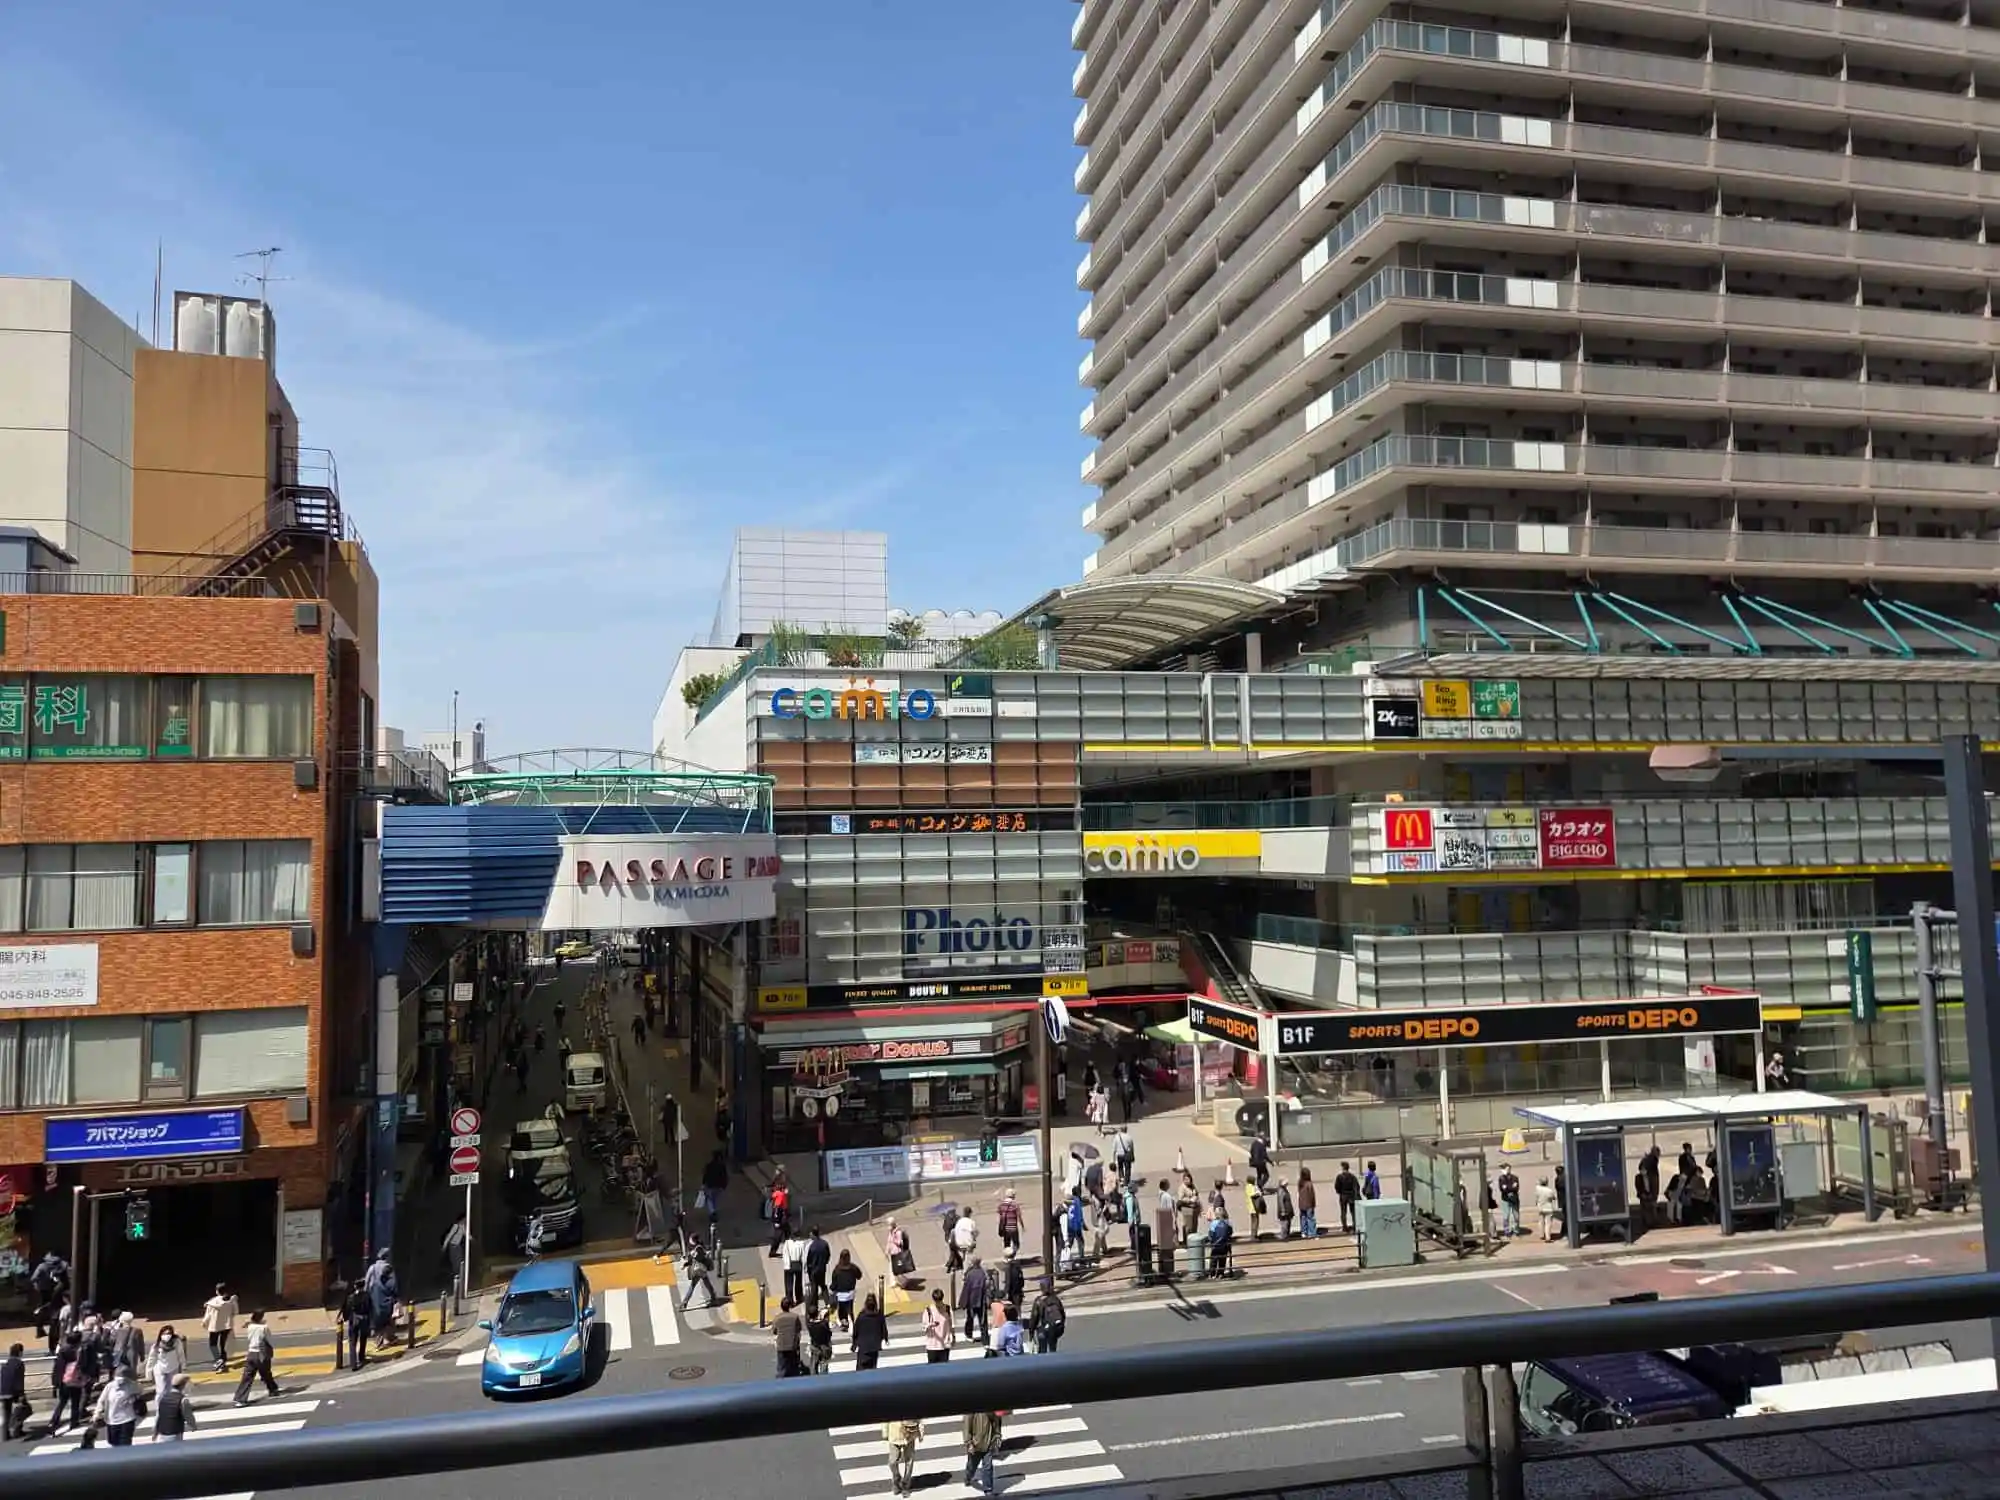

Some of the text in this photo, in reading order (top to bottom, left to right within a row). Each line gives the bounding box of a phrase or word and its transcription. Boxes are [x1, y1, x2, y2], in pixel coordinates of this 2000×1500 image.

[1435, 684, 1450, 693] Eco
[1436, 696, 1456, 707] Ring
[1549, 822, 1606, 838] カラオケ
[577, 856, 733, 883] PASSAGE
[904, 908, 1032, 961] Photo
[1191, 1006, 1205, 1024] B1F
[1226, 1018, 1257, 1042] DEPO
[1350, 1016, 1480, 1040] SPORTS DEPO
[1576, 1007, 1698, 1030] SPORTS DEPO
[1283, 1026, 1315, 1045] B1F
[882, 1039, 949, 1058] Donut
[86, 1122, 170, 1142] アパマンショップ
